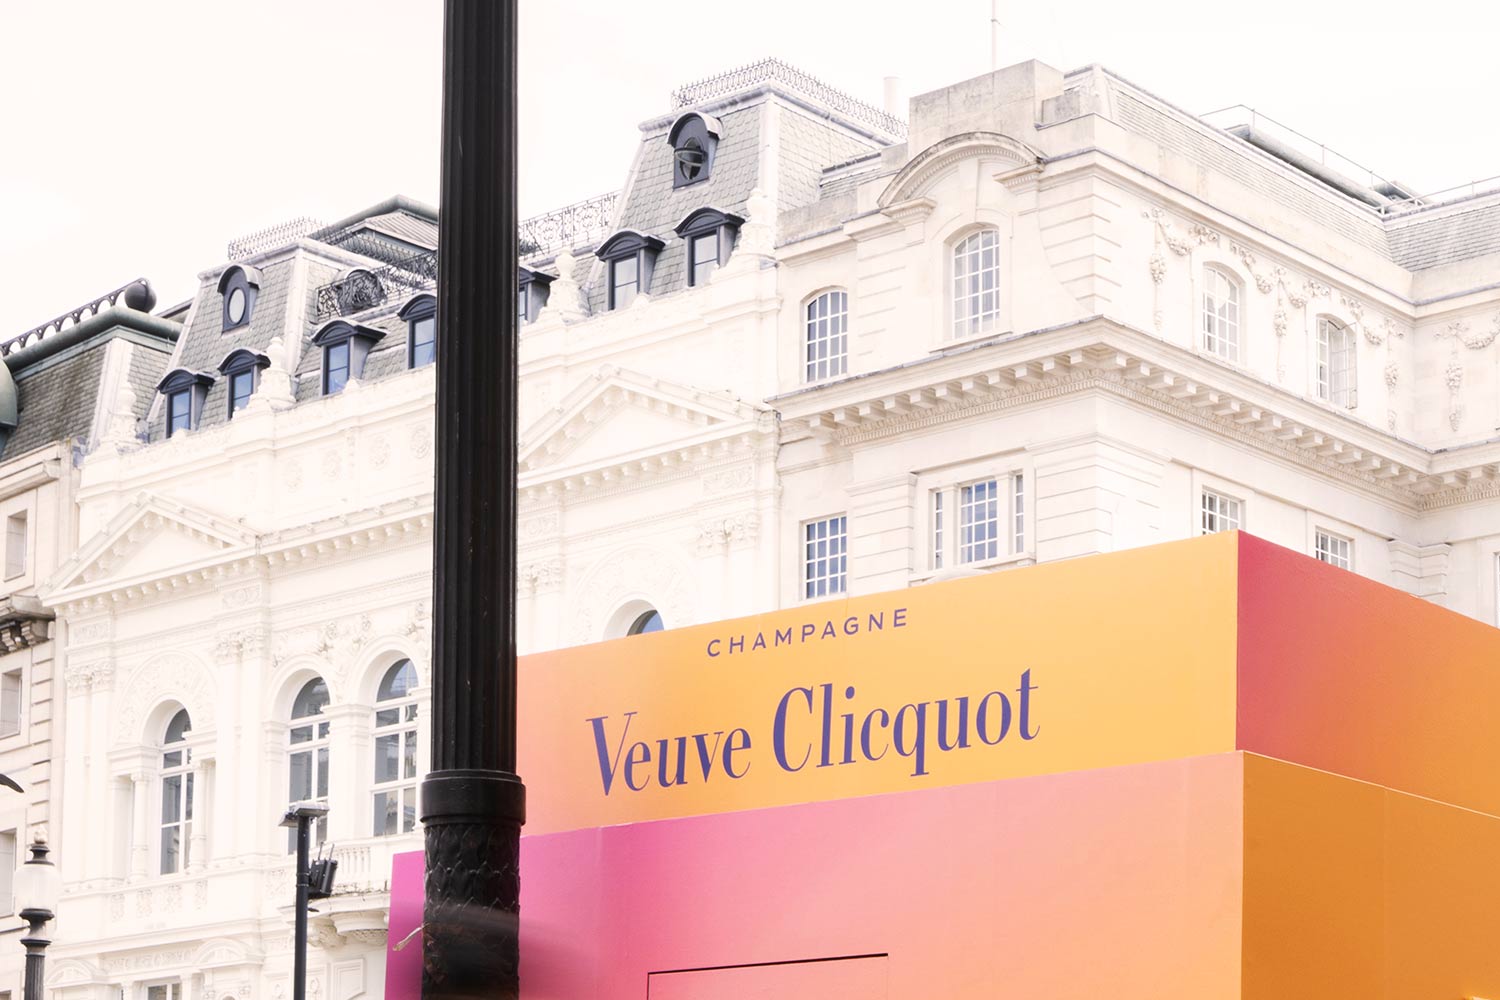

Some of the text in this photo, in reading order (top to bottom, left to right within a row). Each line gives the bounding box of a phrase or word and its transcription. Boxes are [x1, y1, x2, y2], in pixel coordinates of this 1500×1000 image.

[706, 607, 909, 658] CHAMPAGNE
[585, 668, 1041, 797] Veuve Clicquot
